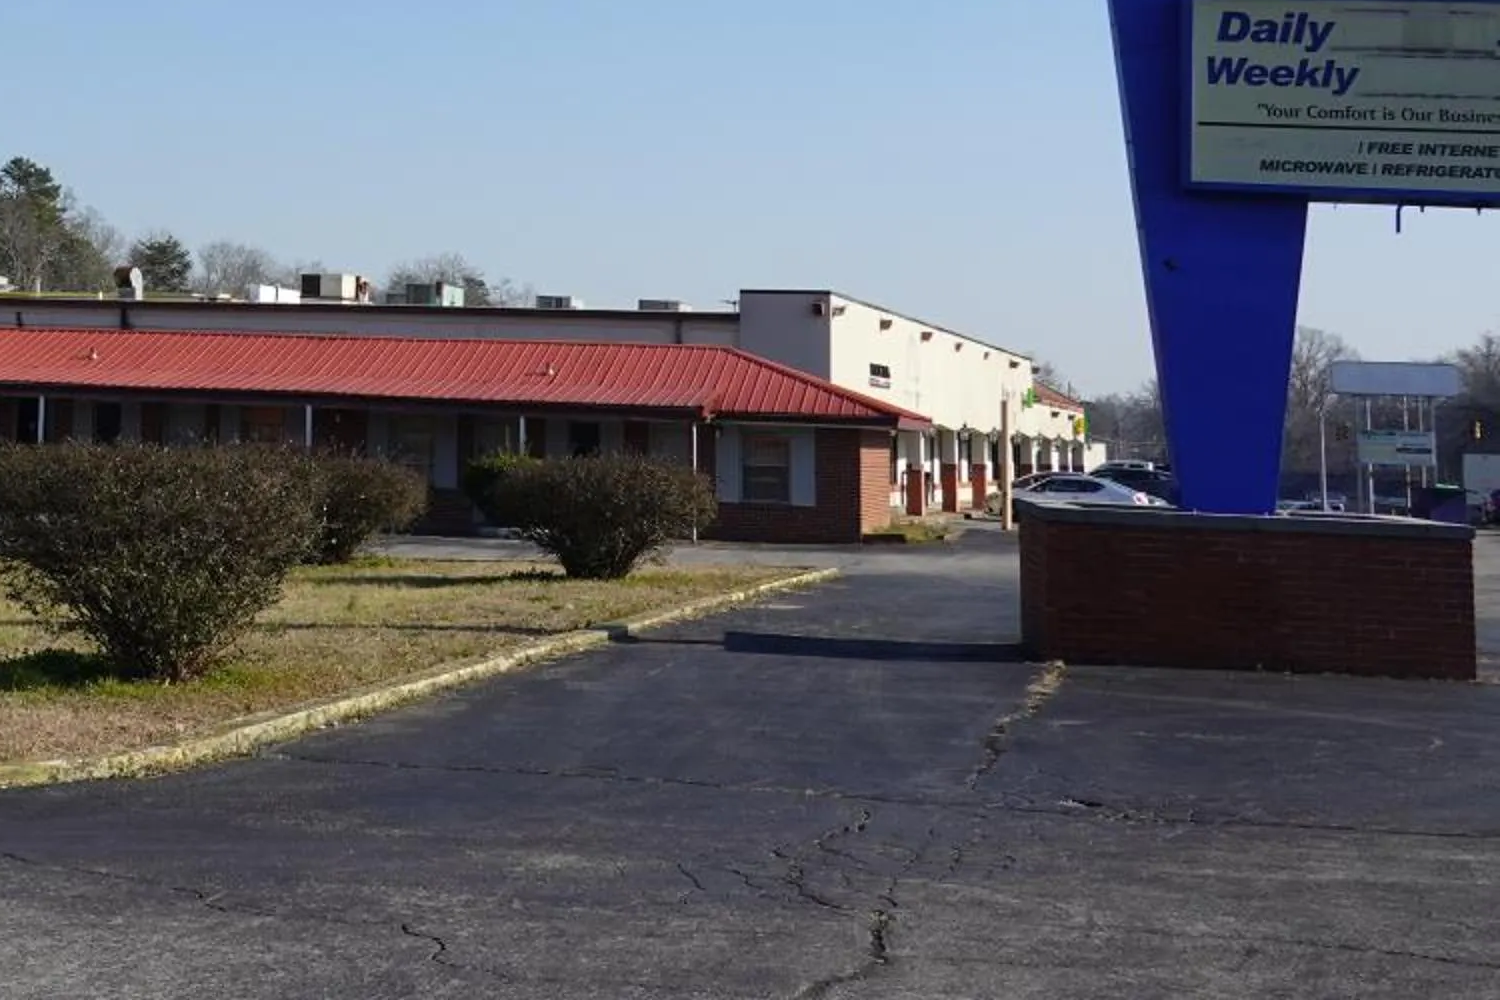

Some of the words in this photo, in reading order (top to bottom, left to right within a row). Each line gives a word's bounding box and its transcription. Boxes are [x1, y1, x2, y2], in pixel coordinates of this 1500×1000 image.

[1217, 10, 1335, 52] Daily
[1206, 55, 1360, 96] Weekly
[1258, 102, 1300, 119] "Your
[1307, 104, 1376, 122] Comfort
[1383, 106, 1395, 121] is
[1401, 107, 1434, 123] Our
[1366, 141, 1413, 156] FREE
[1259, 159, 1367, 175] MICROWAVE
